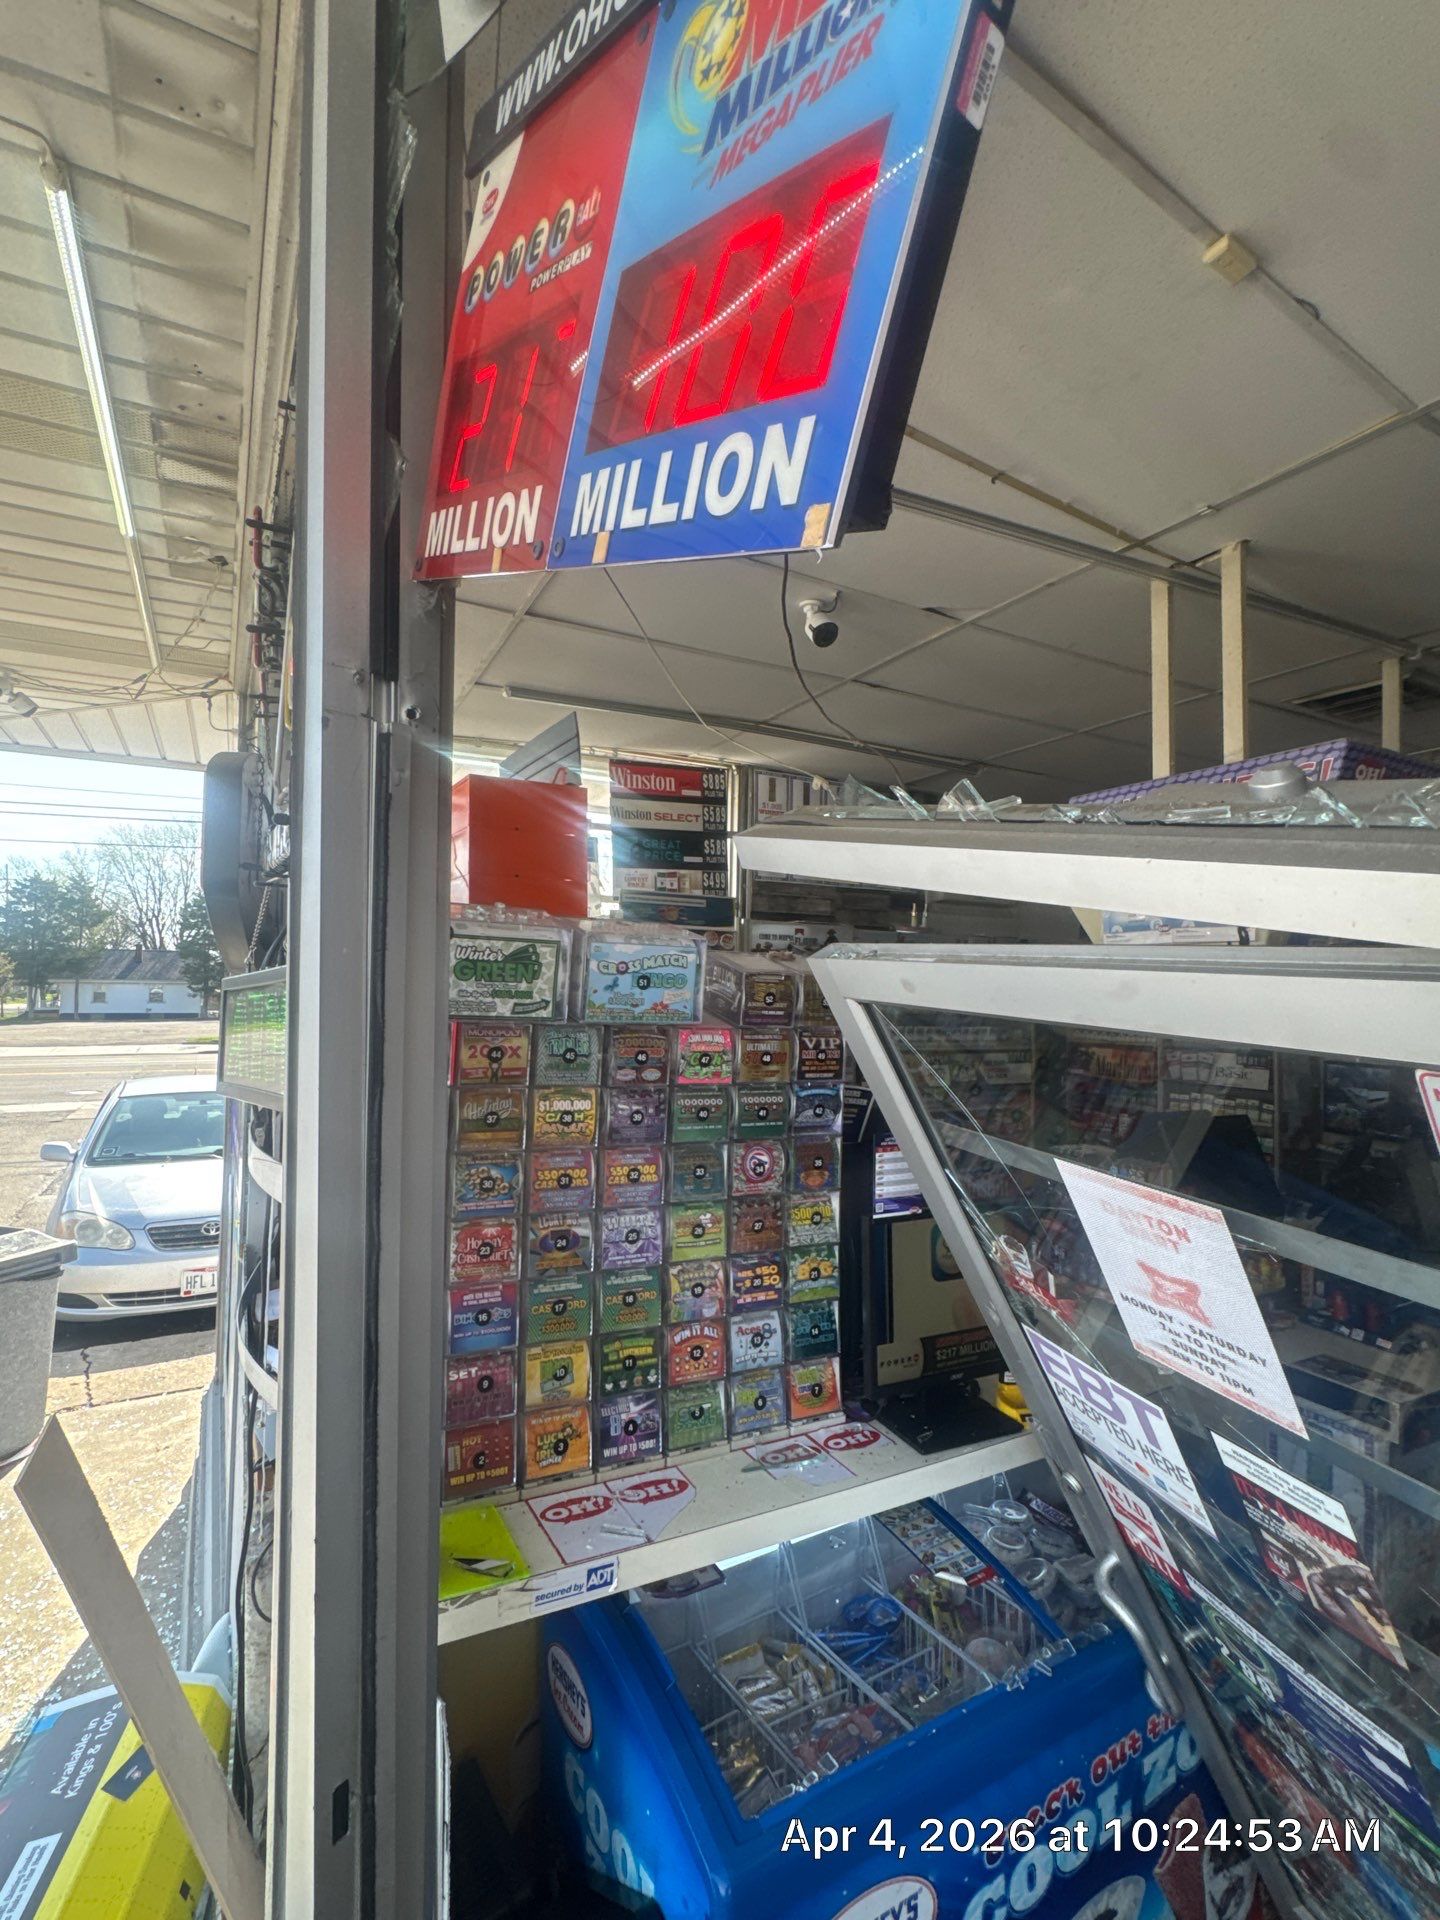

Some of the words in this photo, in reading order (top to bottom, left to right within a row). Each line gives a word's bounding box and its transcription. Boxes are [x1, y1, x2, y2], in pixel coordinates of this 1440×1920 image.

[496, 0, 629, 134] WWW.OHI
[571, 416, 816, 537] MILLION
[425, 485, 543, 558] MILLION
[611, 766, 677, 792] Winston
[612, 806, 652, 821] Winston
[653, 812, 701, 823] SELECT
[455, 944, 506, 963] Winter
[599, 960, 641, 975] CROSS
[643, 954, 689, 970] MATCH
[453, 960, 537, 984] GREEN
[631, 972, 689, 988] BNGO
[801, 1037, 840, 1049] VIP
[469, 1045, 521, 1059] 20X
[565, 1052, 575, 1060] 45
[546, 1112, 585, 1123] CAH
[607, 1173, 658, 1185] CASORD
[630, 1171, 640, 1179] 32
[695, 1168, 704, 1176] 33
[534, 1178, 589, 1190] CASORD
[560, 1177, 570, 1185] 31
[754, 1222, 763, 1230] 27
[556, 1239, 567, 1247] 24
[628, 1233, 638, 1241] 25
[480, 1247, 490, 1255] 23
[186, 1275, 206, 1289] HFL
[605, 1291, 657, 1305] CASORD
[532, 1300, 587, 1315] CASORD
[555, 1303, 564, 1312] 17
[478, 1313, 488, 1322] 16
[674, 1329, 691, 1345] WIN
[692, 1324, 701, 1336] IT
[704, 1326, 719, 1339] ALL
[812, 1327, 819, 1335] 14
[1120, 1291, 1174, 1323] MONDAY
[1188, 1324, 1267, 1368] SATURDAY
[1184, 1333, 1203, 1348] TO
[693, 1350, 701, 1358] 12
[1171, 1338, 1227, 1372] SUNDAY
[625, 1359, 633, 1367] 11
[556, 1368, 565, 1377] 10
[1195, 1361, 1215, 1376] TO
[1220, 1373, 1256, 1398] 11PM
[482, 1379, 489, 1389] 9
[814, 1386, 819, 1394] 7
[1029, 1331, 1164, 1452] EBT
[758, 1399, 763, 1407] 6
[695, 1408, 700, 1416] 5
[627, 1423, 634, 1432] 4
[462, 1435, 483, 1446] HOT
[828, 1430, 874, 1449] OH!
[1053, 1381, 1136, 1451] ACCEPTED
[1137, 1439, 1194, 1492] HERE
[557, 1443, 564, 1452] 3
[603, 1446, 617, 1459] WIN
[617, 1445, 629, 1456] UP
[629, 1442, 638, 1453] TO
[478, 1455, 485, 1465] 2
[450, 1474, 465, 1487] WIN
[465, 1473, 475, 1484] UP
[622, 1479, 680, 1502] OH!
[545, 1496, 605, 1520] OH!
[588, 1567, 614, 1588] ADT
[535, 1582, 572, 1602] secured
[573, 1583, 585, 1593] by
[64, 1757, 95, 1799] Kings
[87, 1744, 102, 1757] &
[96, 1701, 123, 1740] 100's
[51, 1734, 92, 1795] Available
[1090, 1728, 1143, 1787] out
